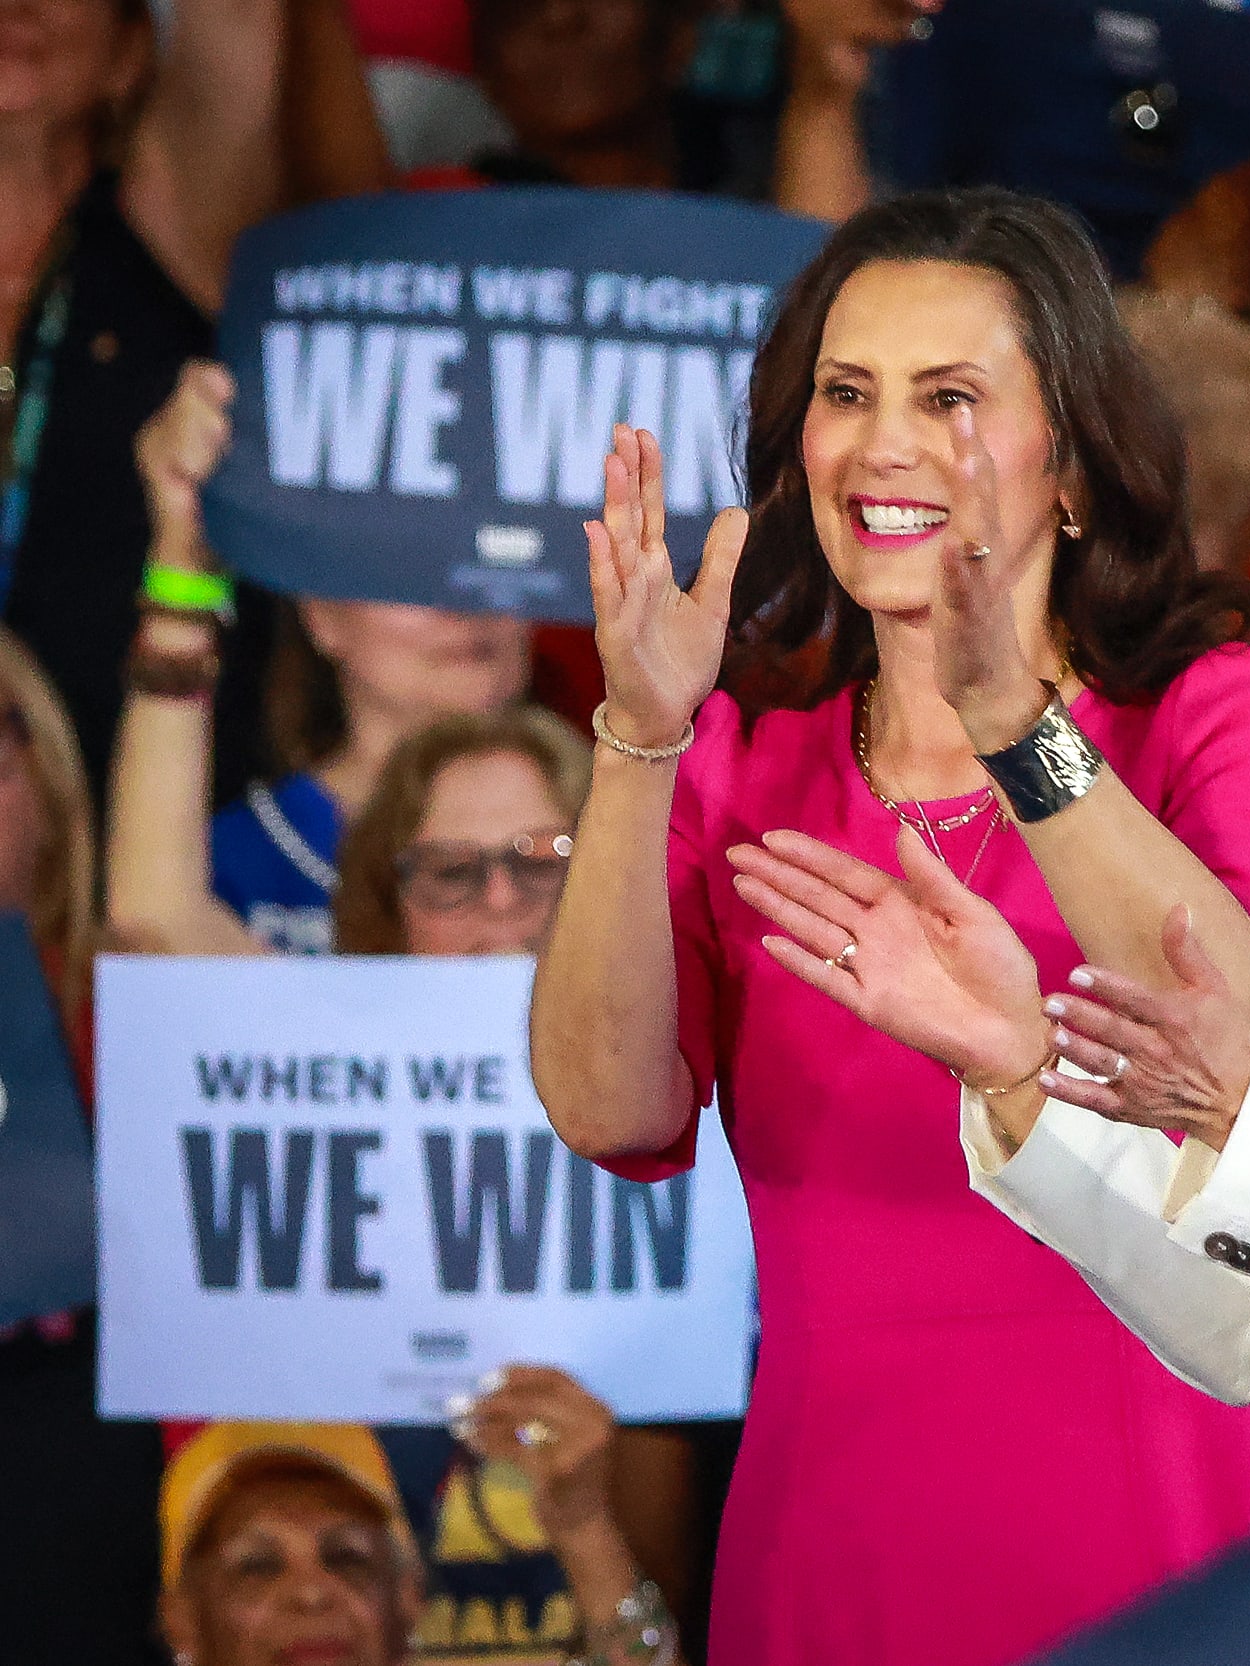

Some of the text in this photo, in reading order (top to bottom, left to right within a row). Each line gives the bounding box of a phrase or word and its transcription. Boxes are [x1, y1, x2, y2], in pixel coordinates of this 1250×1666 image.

[275, 261, 770, 340] WHEN WE FIGHT
[262, 321, 755, 517] WE WIN
[197, 1055, 503, 1103] WHEN WE
[181, 1127, 688, 1293] WE WIN
